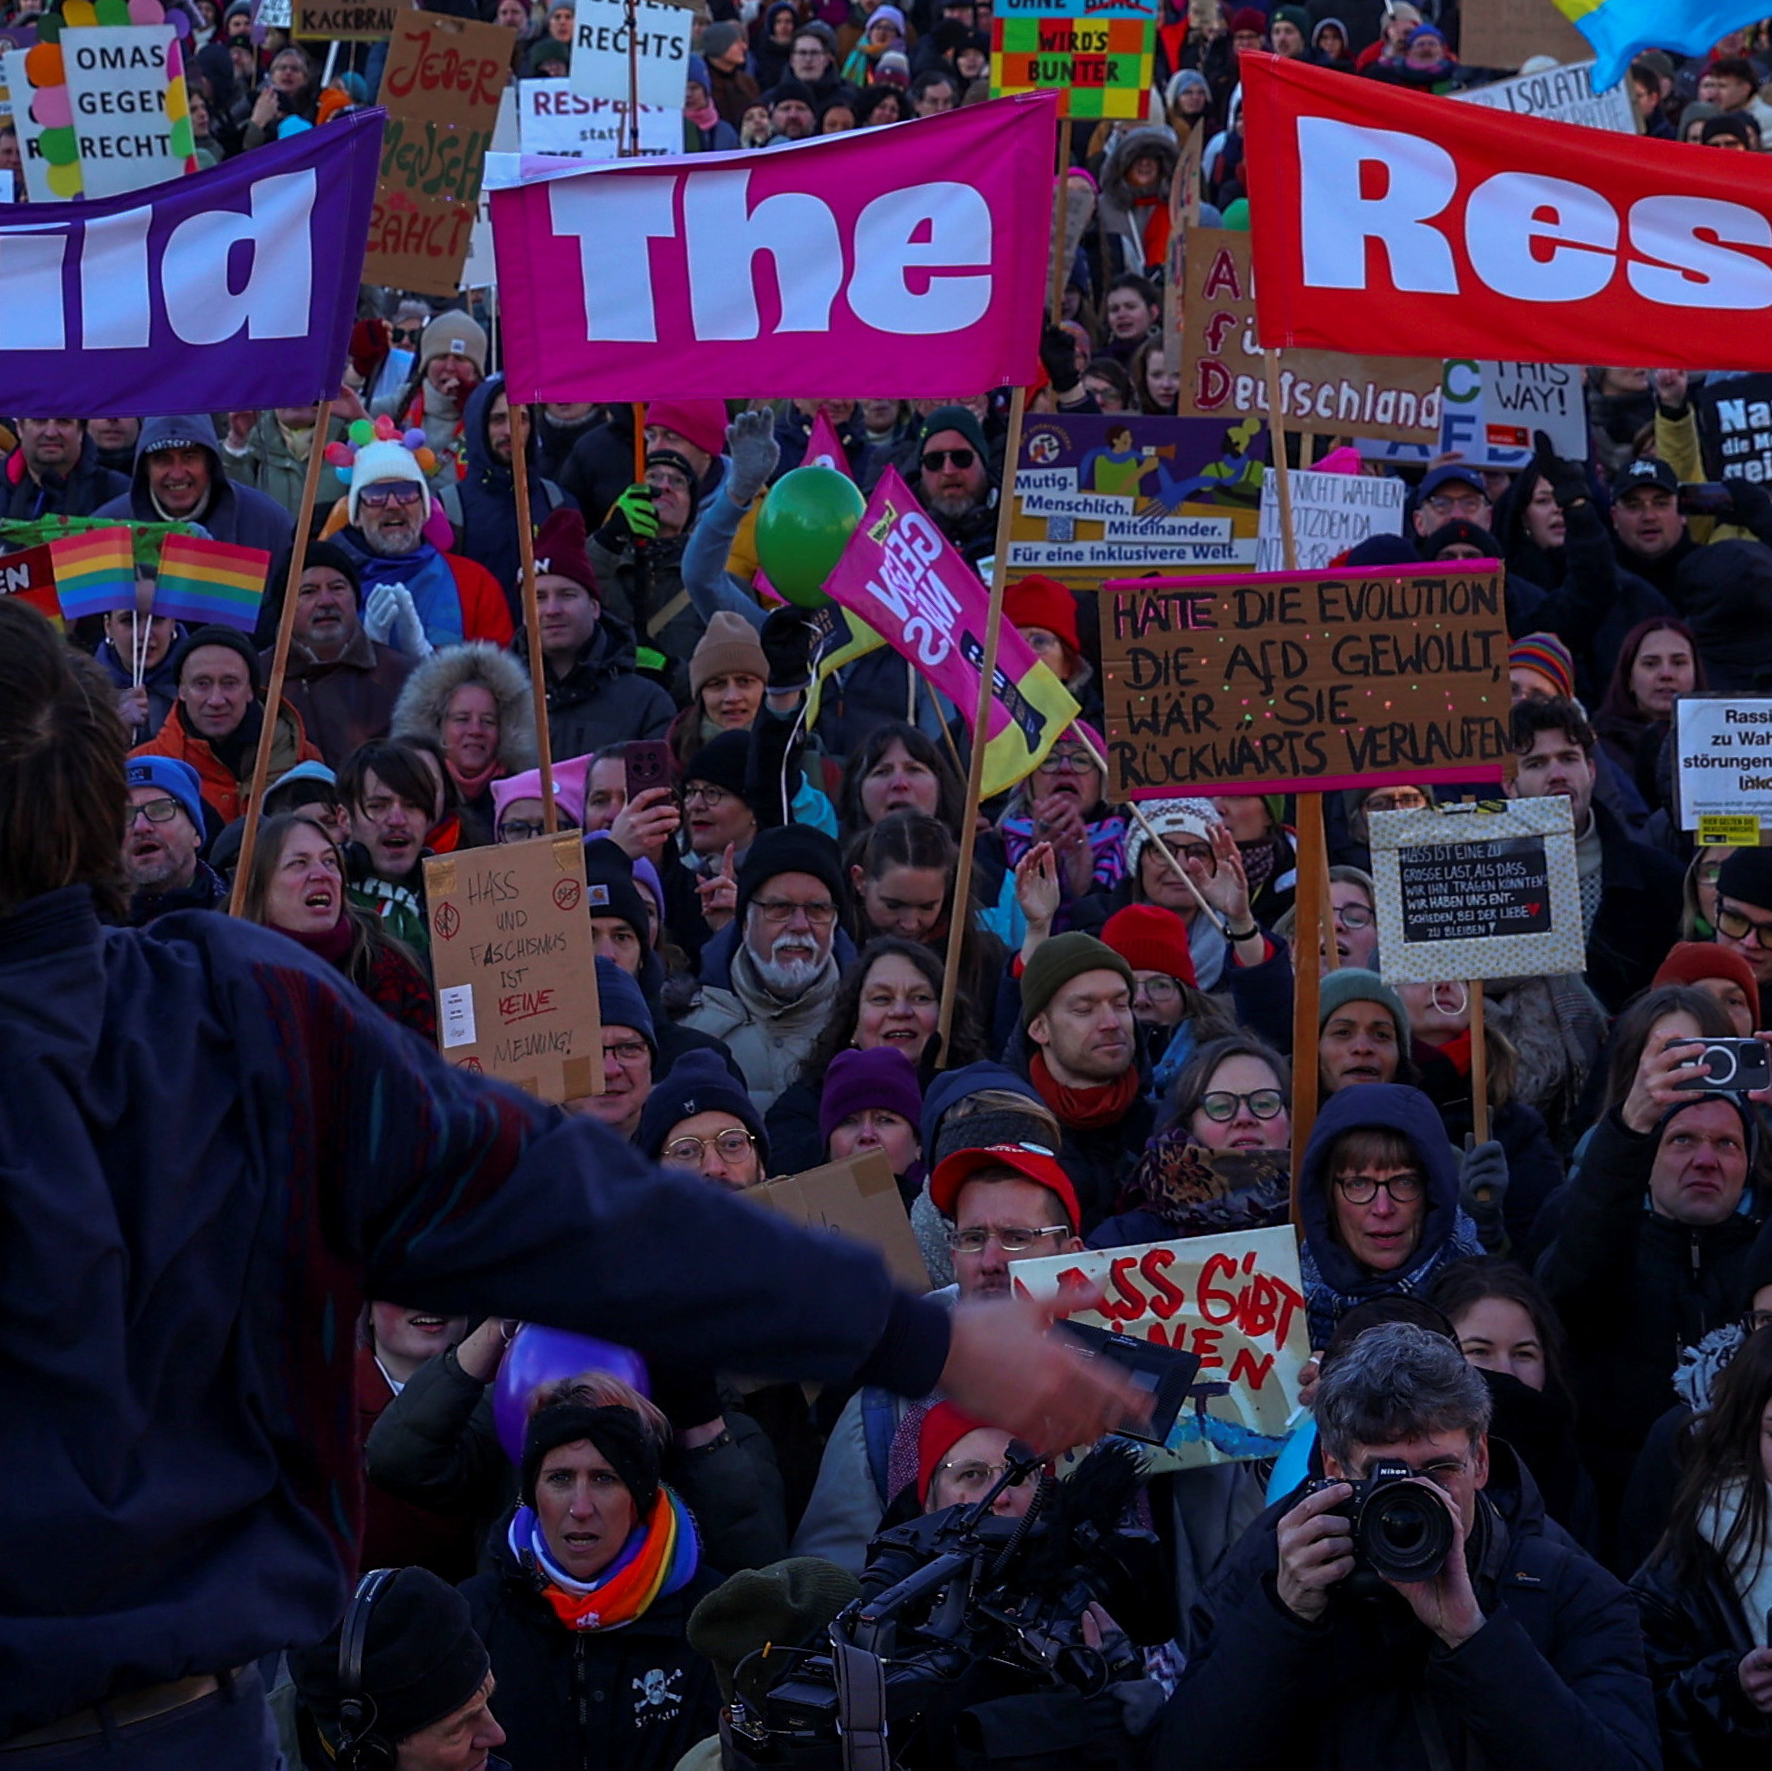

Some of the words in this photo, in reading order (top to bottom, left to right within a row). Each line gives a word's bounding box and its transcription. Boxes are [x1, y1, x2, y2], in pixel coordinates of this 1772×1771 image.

[301, 7, 400, 32] KACKBRAU
[578, 25, 684, 60] RECHTS
[1038, 28, 1110, 52] WIRD'S
[76, 45, 166, 71] OMAS
[1027, 59, 1120, 83] BUNTER
[78, 90, 166, 116] GEGEN
[548, 168, 993, 343] The
[1495, 380, 1568, 418] WAY!
[1014, 473, 1074, 493] Mutig.
[1294, 481, 1338, 504] NICHT
[1025, 494, 1131, 517] Menschlich.
[1108, 520, 1225, 539] Miteinander.
[1012, 547, 1042, 563] Für
[1045, 547, 1085, 563] eine
[1089, 545, 1186, 563] inklusivere
[1190, 543, 1241, 562] Welt.
[1113, 586, 1214, 639] HÄTTE
[1231, 582, 1304, 628] DIE
[1319, 576, 1499, 623] EVOLUTION
[1125, 646, 1198, 691] DIE
[1225, 637, 1310, 698] AfD
[1333, 630, 1502, 684] GEWOLLT,
[1126, 692, 1216, 737] WÄR
[1285, 683, 1359, 728] SIE
[1711, 734, 1733, 747] zu
[1116, 713, 1328, 794] RÜCKWÄRTS
[1347, 712, 1514, 771] VERLAUFEN
[1682, 753, 1772, 771] störungen
[1401, 845, 1432, 864] HASS
[1433, 844, 1454, 863] IST
[1455, 844, 1486, 862] EINE
[1487, 842, 1502, 858] ZU
[1474, 863, 1495, 878] ALS
[1496, 861, 1528, 877] DASS
[467, 870, 520, 907] HASS
[1404, 884, 1427, 897] WIR
[1428, 882, 1449, 896] IHN
[1406, 897, 1428, 911] WIR
[1429, 895, 1464, 909] HABEN
[1466, 895, 1487, 907] UNS
[1488, 892, 1516, 906] ENT-
[1456, 909, 1475, 922] BEI
[1476, 908, 1498, 921] DER
[1499, 905, 1531, 920] LIEBE
[495, 909, 529, 933] UND
[1428, 927, 1442, 939] ZU
[1444, 924, 1487, 938] BLEIBEN
[469, 932, 569, 969] FASCHISMUS
[500, 966, 529, 989] IST
[498, 989, 555, 1016] KEINE
[1380, 1468, 1408, 1476] Nikon
